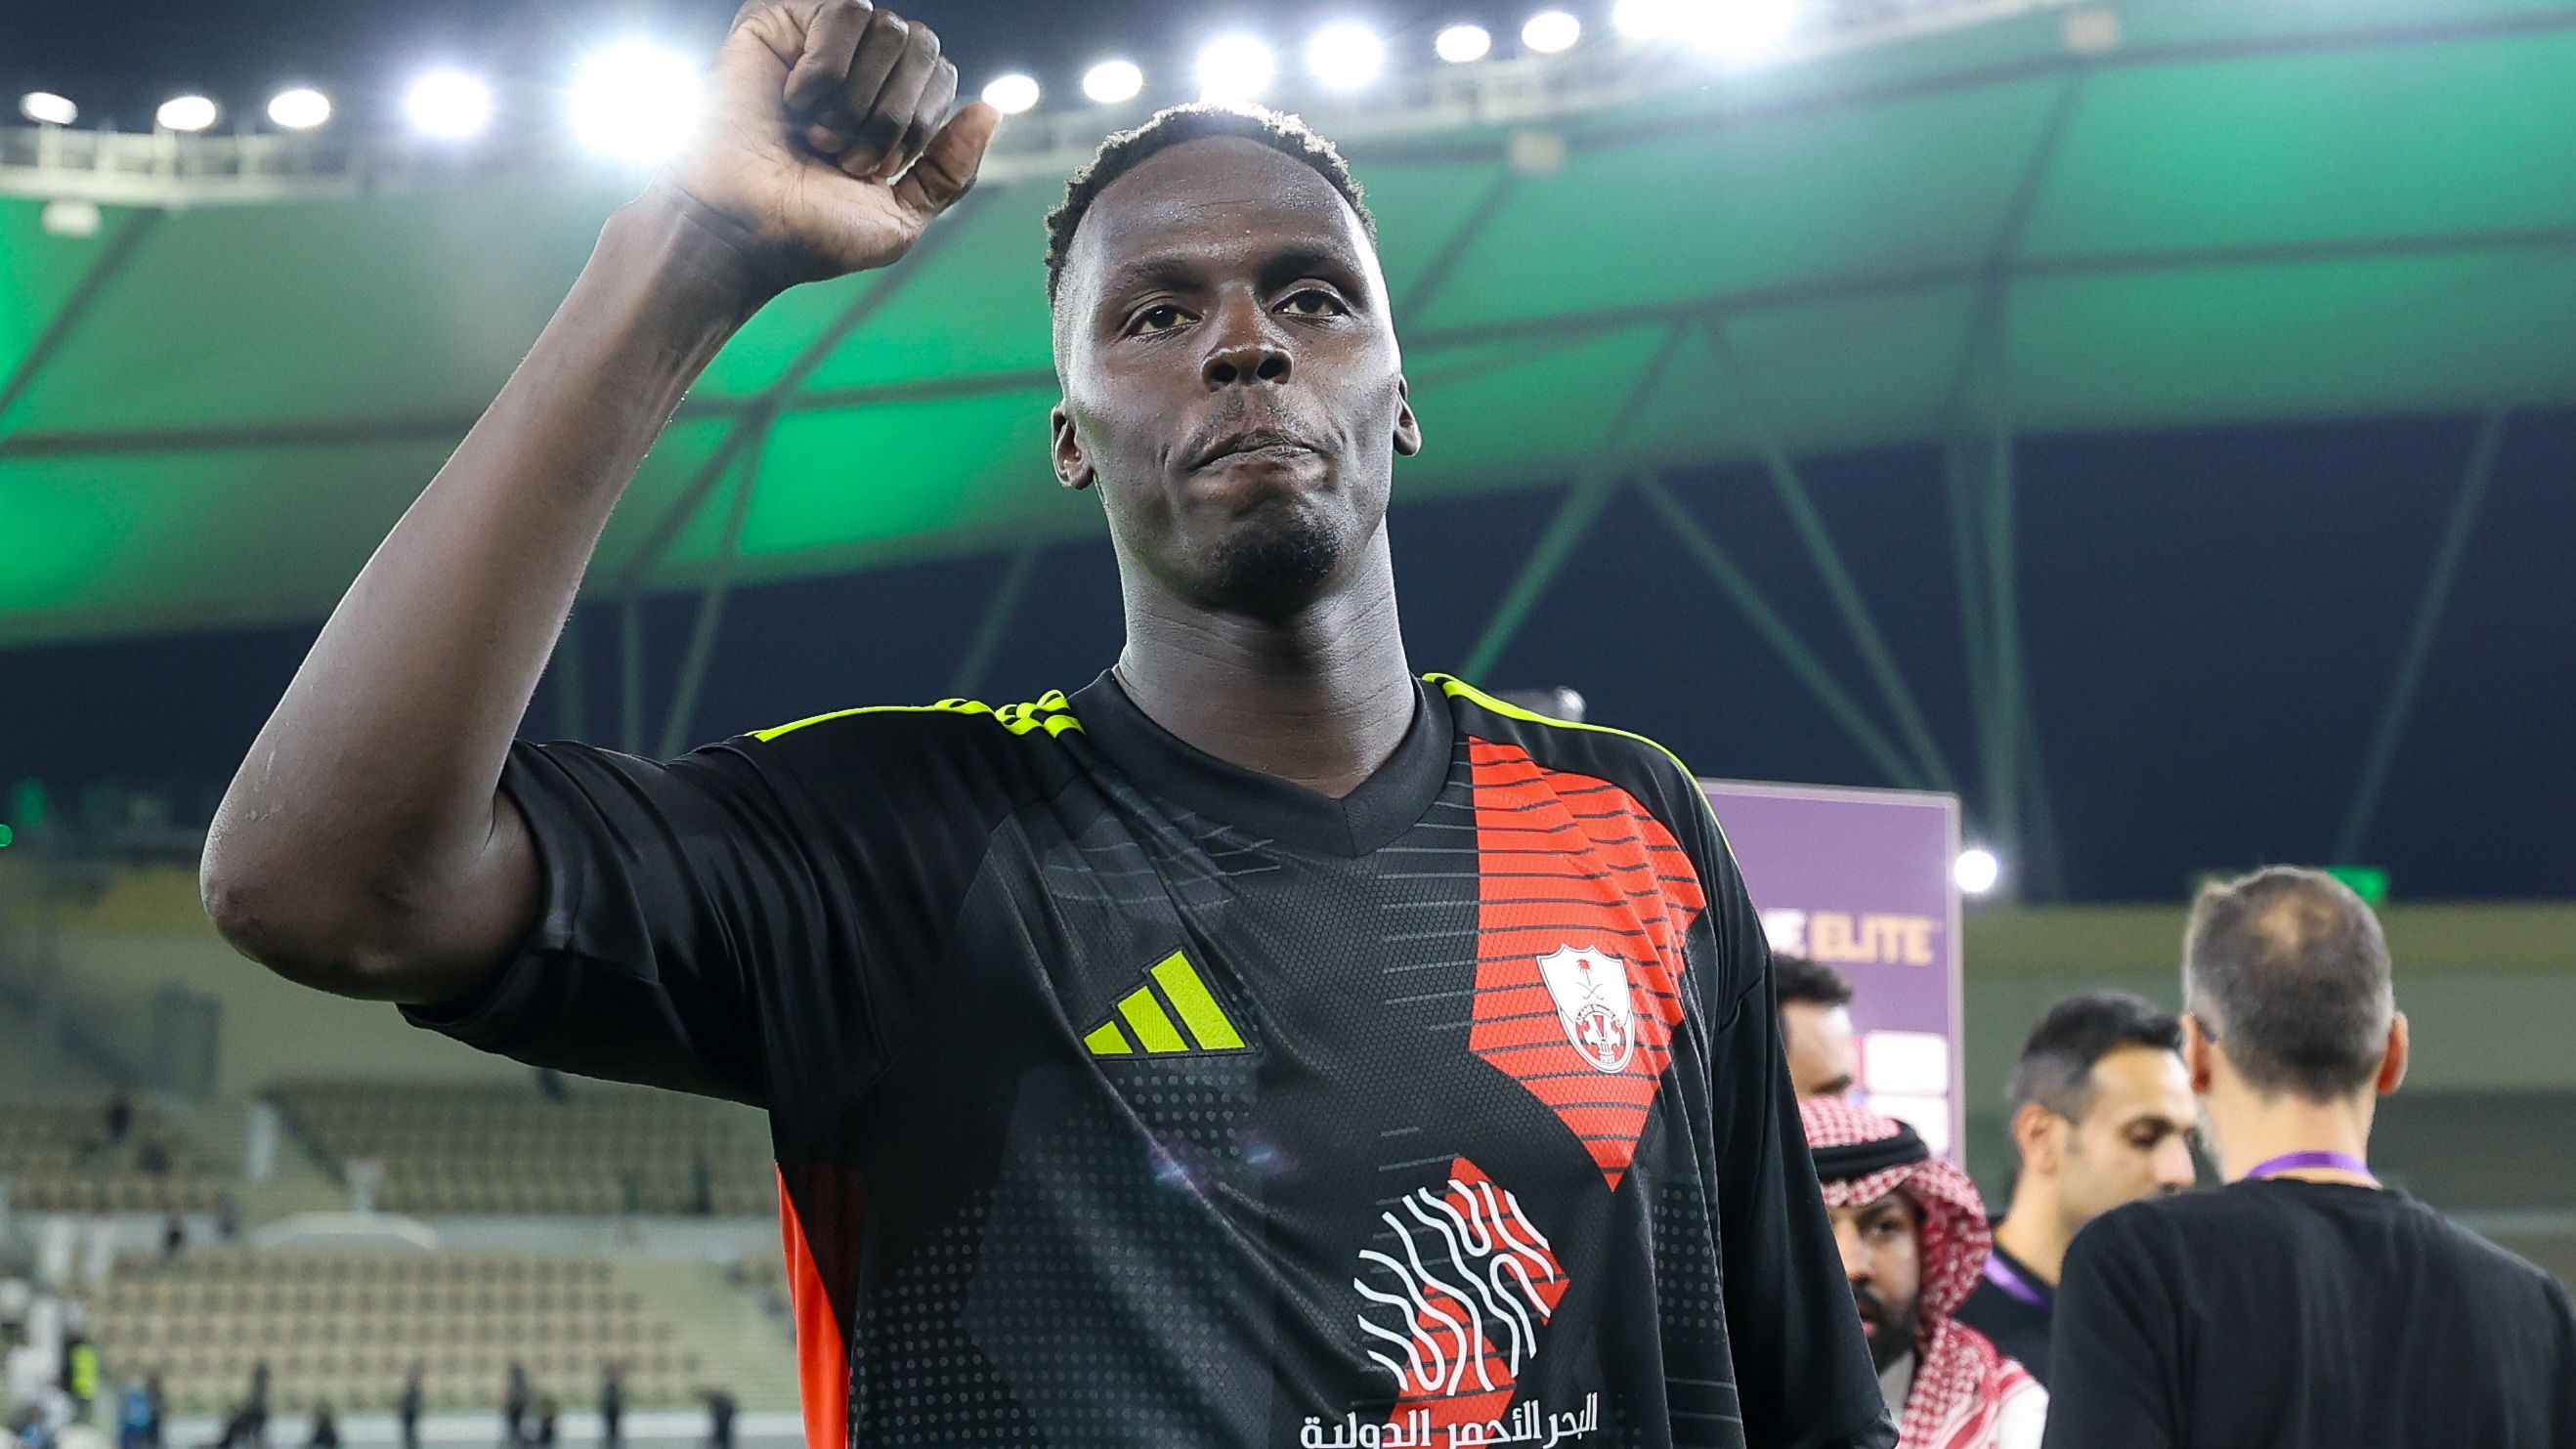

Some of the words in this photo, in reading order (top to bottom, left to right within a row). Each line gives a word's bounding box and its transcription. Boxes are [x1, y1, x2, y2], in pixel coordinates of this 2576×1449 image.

[1810, 911, 1934, 966] ELITE
[1446, 1399, 1542, 1449] الأحمر
[1542, 1391, 1598, 1449] البحر
